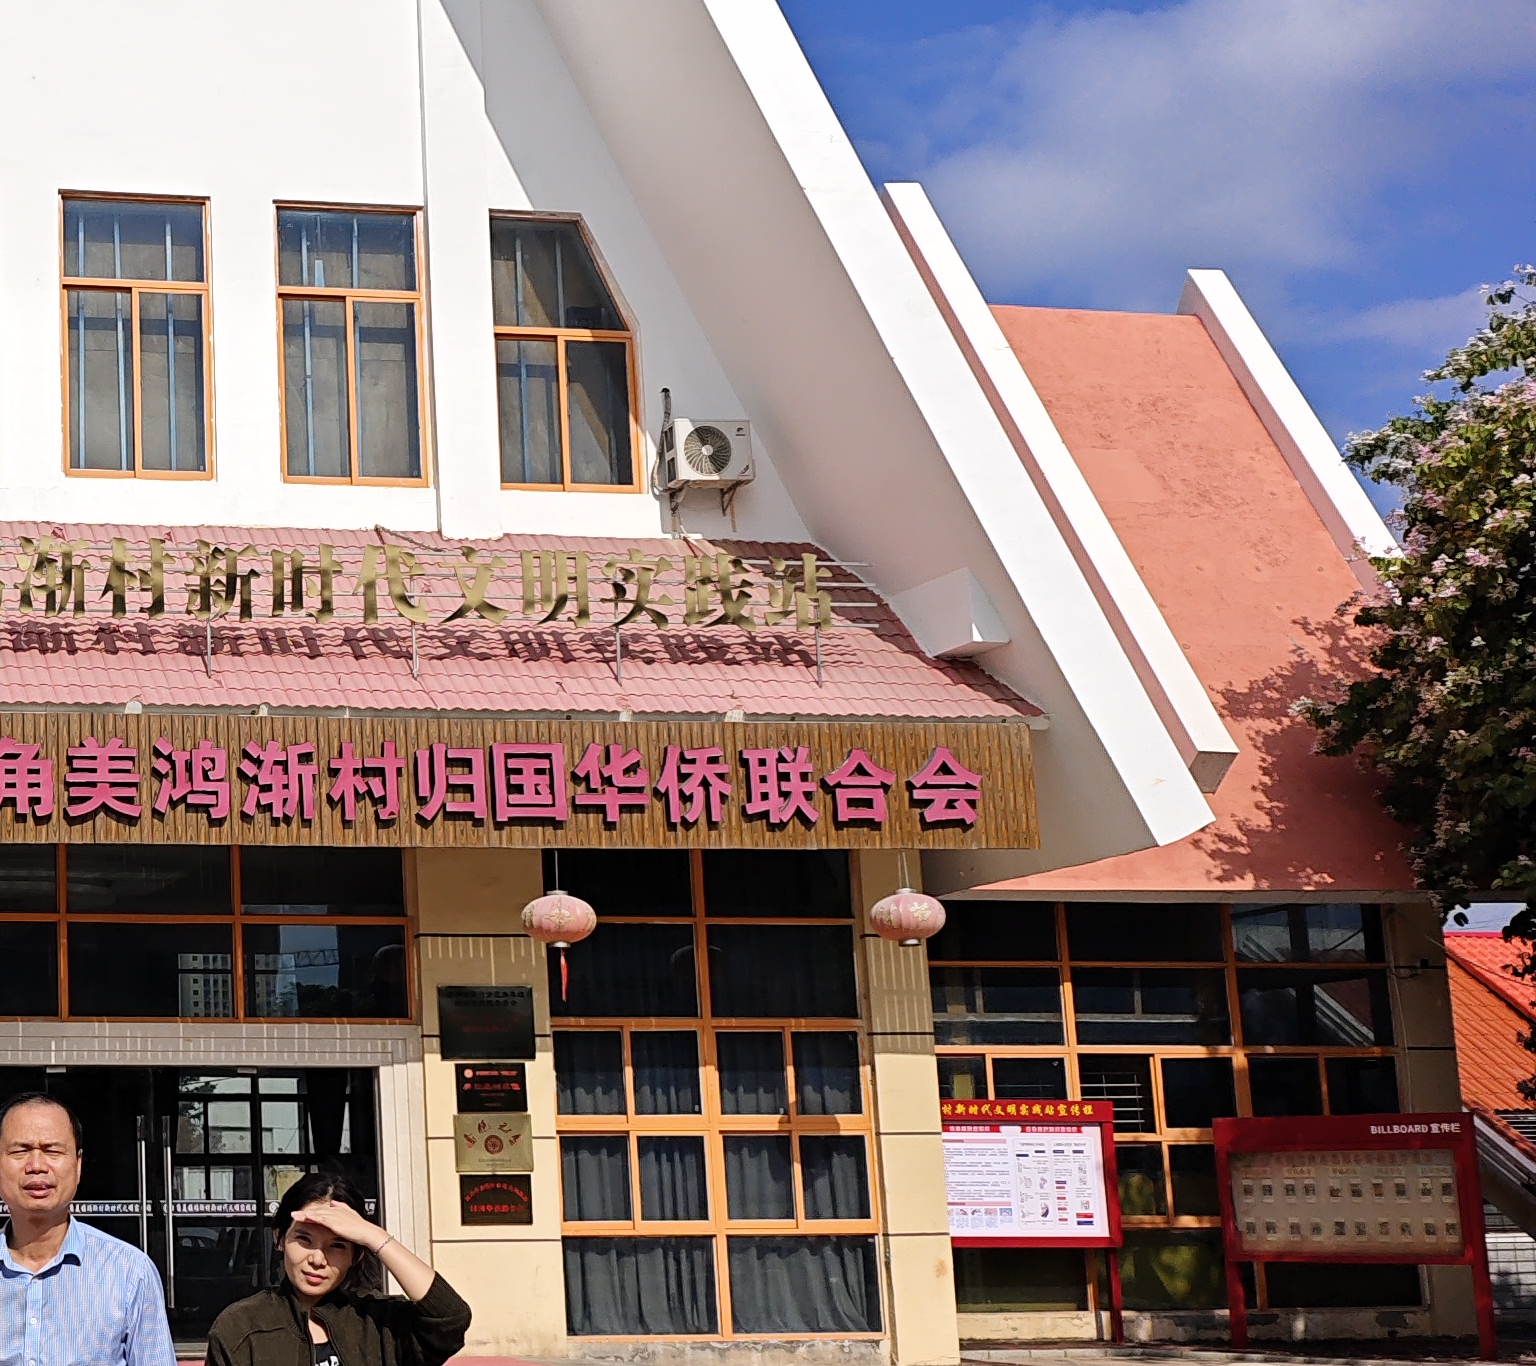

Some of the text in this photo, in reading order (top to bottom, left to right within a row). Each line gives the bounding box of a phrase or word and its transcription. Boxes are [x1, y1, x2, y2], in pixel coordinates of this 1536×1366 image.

[1370, 1122, 1461, 1135] BILLBOARD 宣传栏
